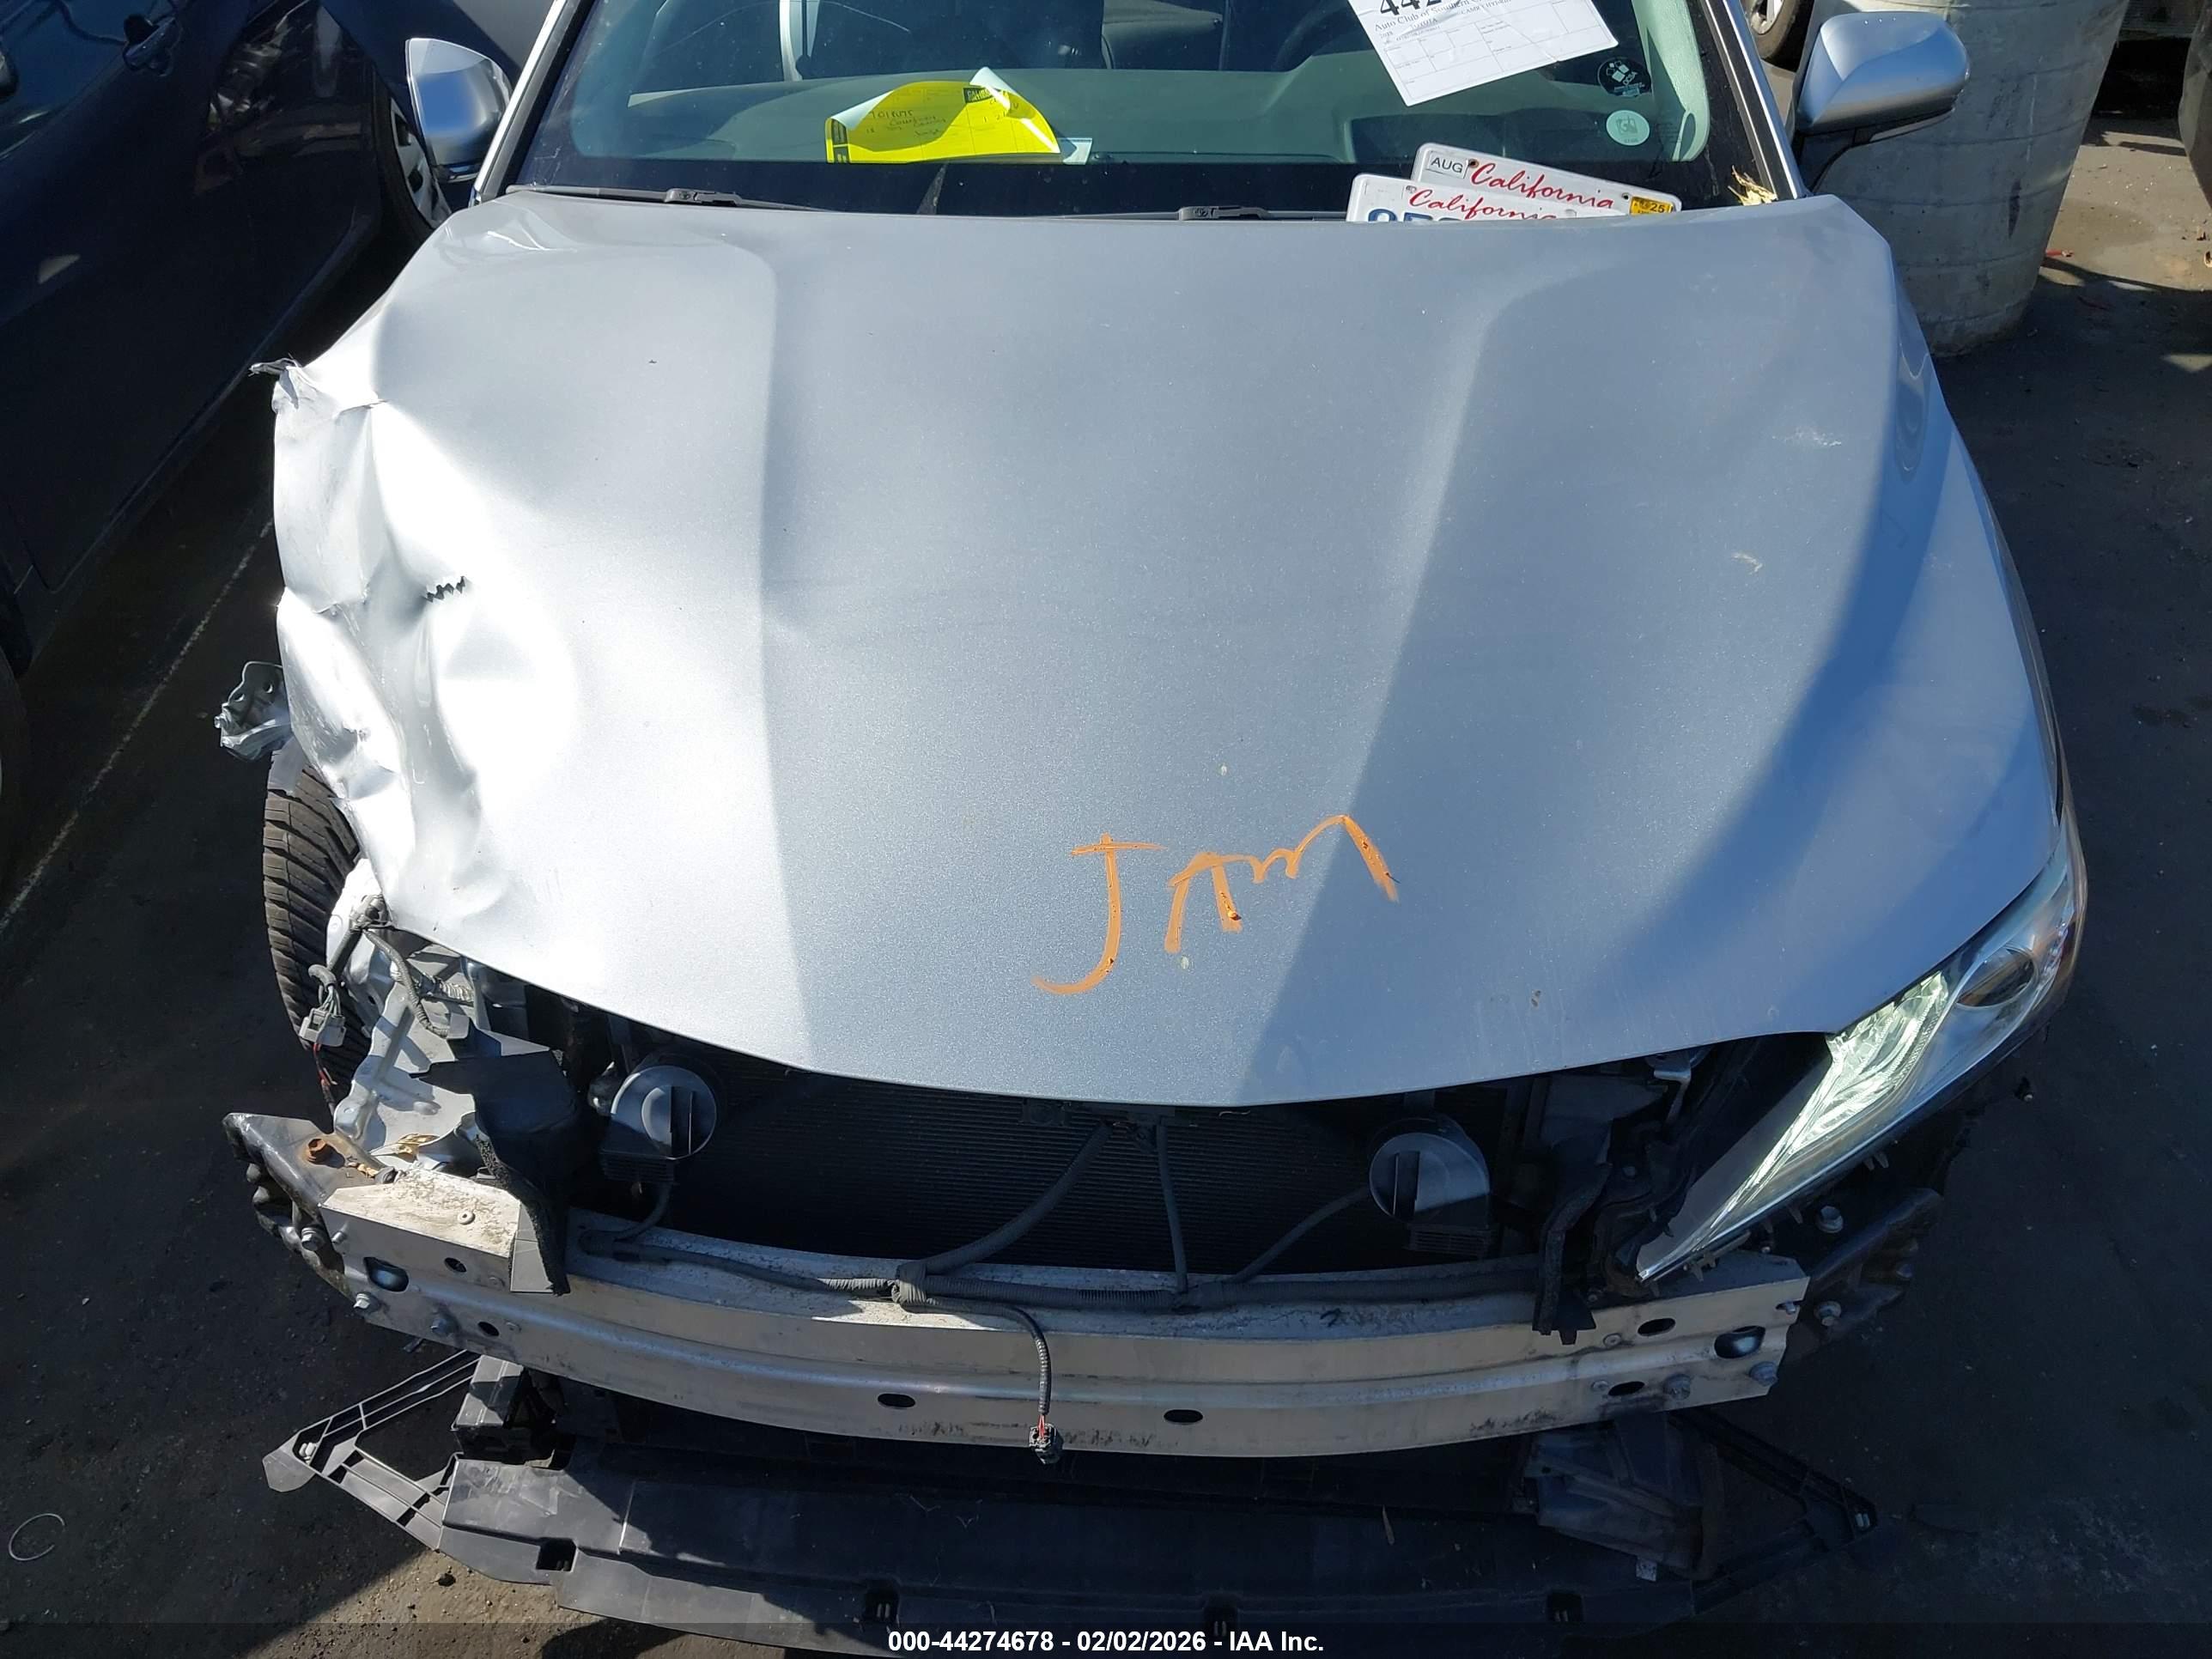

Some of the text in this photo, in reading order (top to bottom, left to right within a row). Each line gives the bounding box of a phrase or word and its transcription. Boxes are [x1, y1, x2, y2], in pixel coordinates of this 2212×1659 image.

[1375, 19, 1396, 32] Auto
[1397, 11, 1419, 25] Club
[1431, 157, 1463, 173] AUG
[1470, 162, 1614, 210] California
